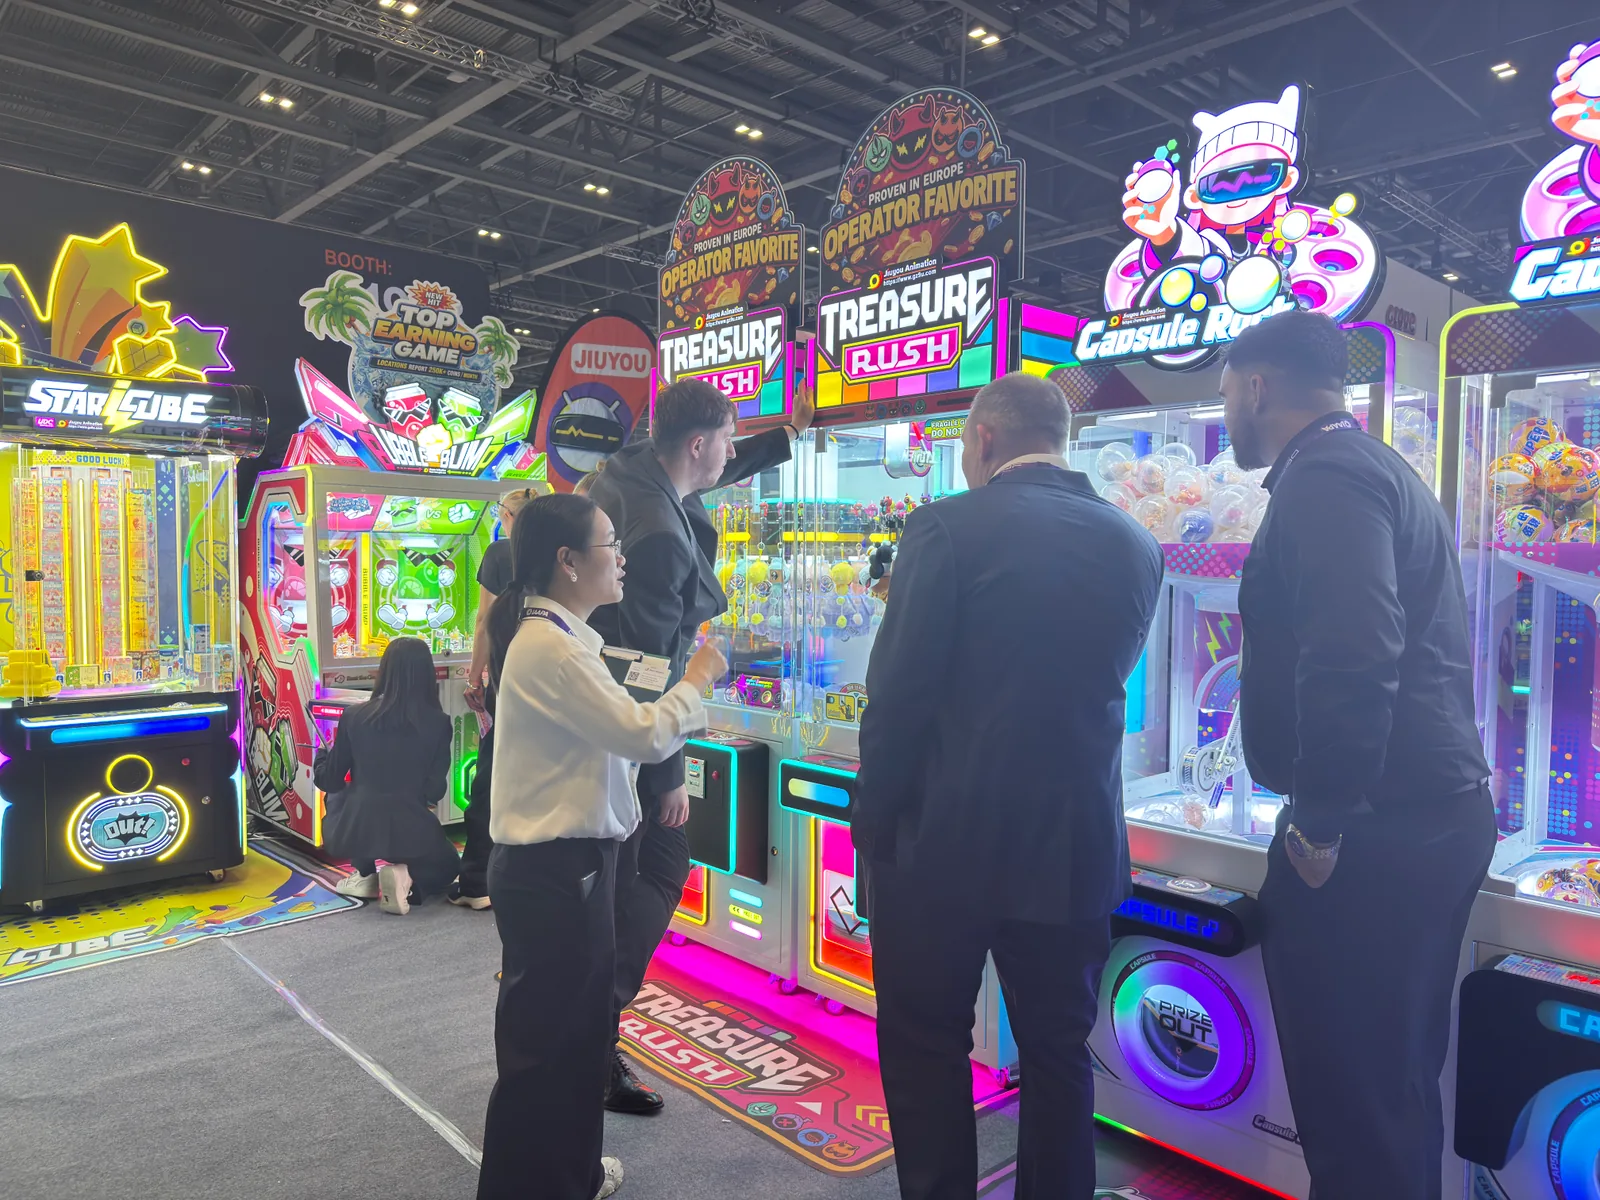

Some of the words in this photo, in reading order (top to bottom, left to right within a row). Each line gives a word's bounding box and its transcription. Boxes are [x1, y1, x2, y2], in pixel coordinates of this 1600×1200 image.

[868, 182, 906, 205] PROVEN
[909, 177, 921, 192] IN
[923, 162, 964, 187] EUROPE
[824, 195, 920, 261] OPERATOR
[925, 170, 1017, 219] FAVORITE
[693, 237, 722, 253] PROVEN
[723, 233, 732, 244] IN
[733, 222, 763, 241] EUROPE
[325, 249, 393, 275] BOOTH:
[661, 252, 732, 295] OPERATOR
[734, 234, 799, 269] FAVORITE
[905, 258, 937, 272] Animation
[425, 291, 444, 303] NEW
[426, 298, 441, 306] HIT
[820, 266, 993, 357] TREASURE
[400, 307, 453, 329] TOP
[373, 319, 477, 351] EARNING
[660, 315, 782, 384] TREASURE
[1075, 311, 1201, 359] Capsule
[377, 359, 408, 369] LOCATIONS
[408, 363, 428, 372] REPORT
[428, 366, 447, 375] 250K+
[394, 343, 461, 365] GAME
[574, 350, 647, 373] JIUYOU
[851, 333, 950, 376] RUSH
[23, 379, 109, 417] STAR
[119, 388, 213, 424] CUBE
[931, 420, 959, 428] FRAGILE
[931, 429, 944, 437] DO
[945, 428, 963, 436] NOT
[76, 454, 100, 464] GOOD
[103, 456, 125, 466] LUCK!
[357, 423, 430, 471] BUBBLE
[440, 435, 506, 477] BUMP
[426, 509, 442, 519] VS
[1113, 898, 1200, 935] APSULE
[1129, 953, 1157, 970] CAPSULE
[1159, 1000, 1213, 1028] PRIZE
[1159, 1014, 1213, 1043] OUT
[619, 1018, 736, 1082] RUSH
[633, 982, 832, 1092] TREASURE
[1252, 1114, 1298, 1142] Capsule
[1550, 1140, 1561, 1185] CAPSULE
